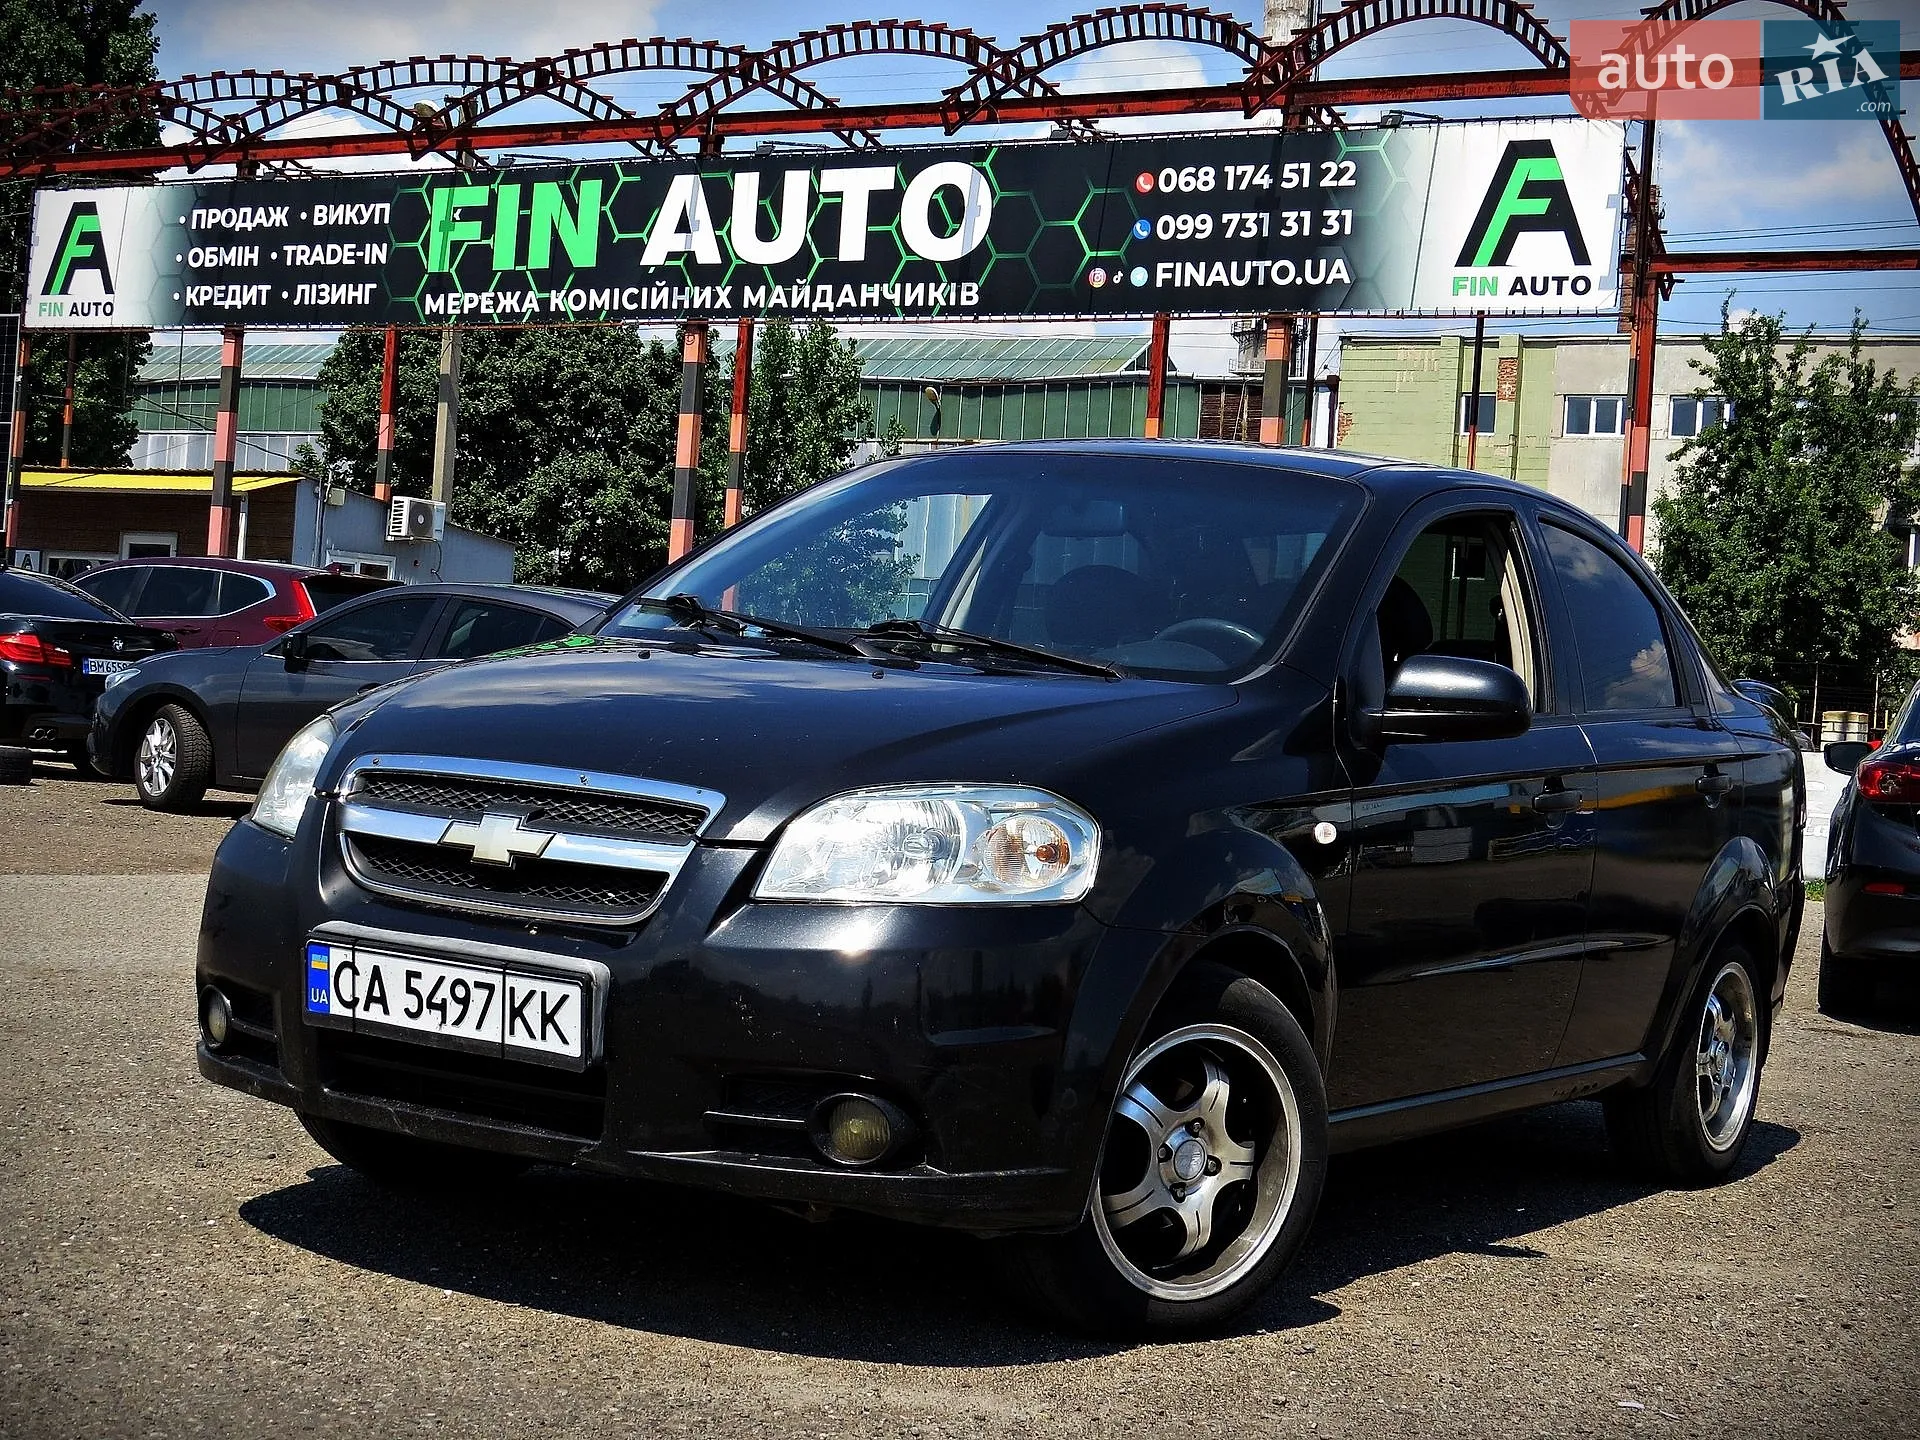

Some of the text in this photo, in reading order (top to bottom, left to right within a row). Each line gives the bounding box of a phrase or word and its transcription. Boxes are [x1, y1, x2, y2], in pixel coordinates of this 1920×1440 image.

[1158, 160, 1357, 192] 068 174 51 22
[190, 202, 391, 231] ПРОДАЖ ВИКУП
[427, 161, 993, 272] FIN AUTO
[1156, 209, 1353, 241] 099 731 31 31
[187, 243, 259, 268] ОБМІН
[283, 241, 388, 268] TRADE-IN
[1155, 257, 1351, 288] FINAUTO.UA
[1452, 275, 1592, 297] FIN AUTO
[185, 281, 378, 308] КРЕДИТ ЛІЗИНГ
[425, 278, 980, 315] МЕРЕЖА КОМІСІЙНИХ МАЙДАНЧИКІВ
[38, 302, 115, 317] FIN AUTO
[311, 987, 329, 1004] UA
[333, 960, 570, 1046] CA 5497 KK
